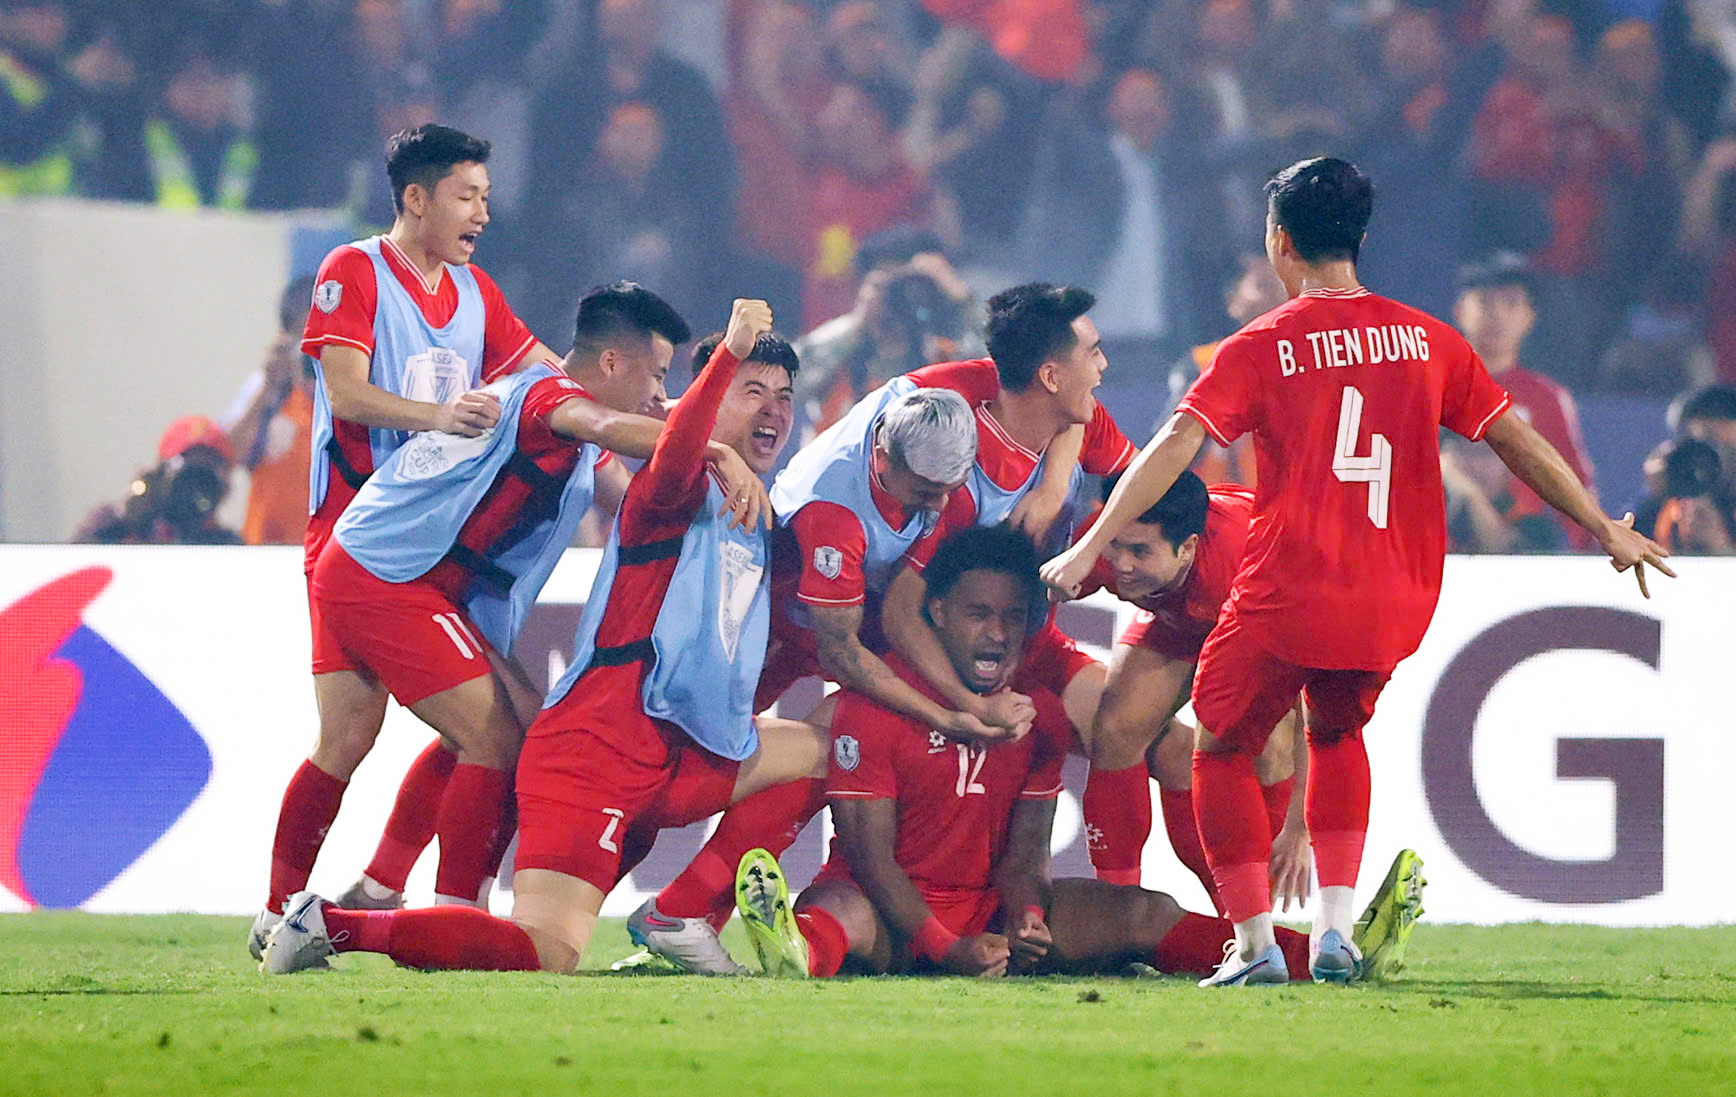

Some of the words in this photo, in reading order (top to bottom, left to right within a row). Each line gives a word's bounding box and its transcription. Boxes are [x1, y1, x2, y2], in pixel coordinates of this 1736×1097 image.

[1276, 339, 1305, 377] B.
[1305, 327, 1364, 370] TIEN
[1365, 324, 1430, 362] DUNG
[1331, 385, 1393, 529] 4
[431, 612, 485, 660] 11
[955, 743, 987, 798] 12
[598, 807, 625, 855] 2
